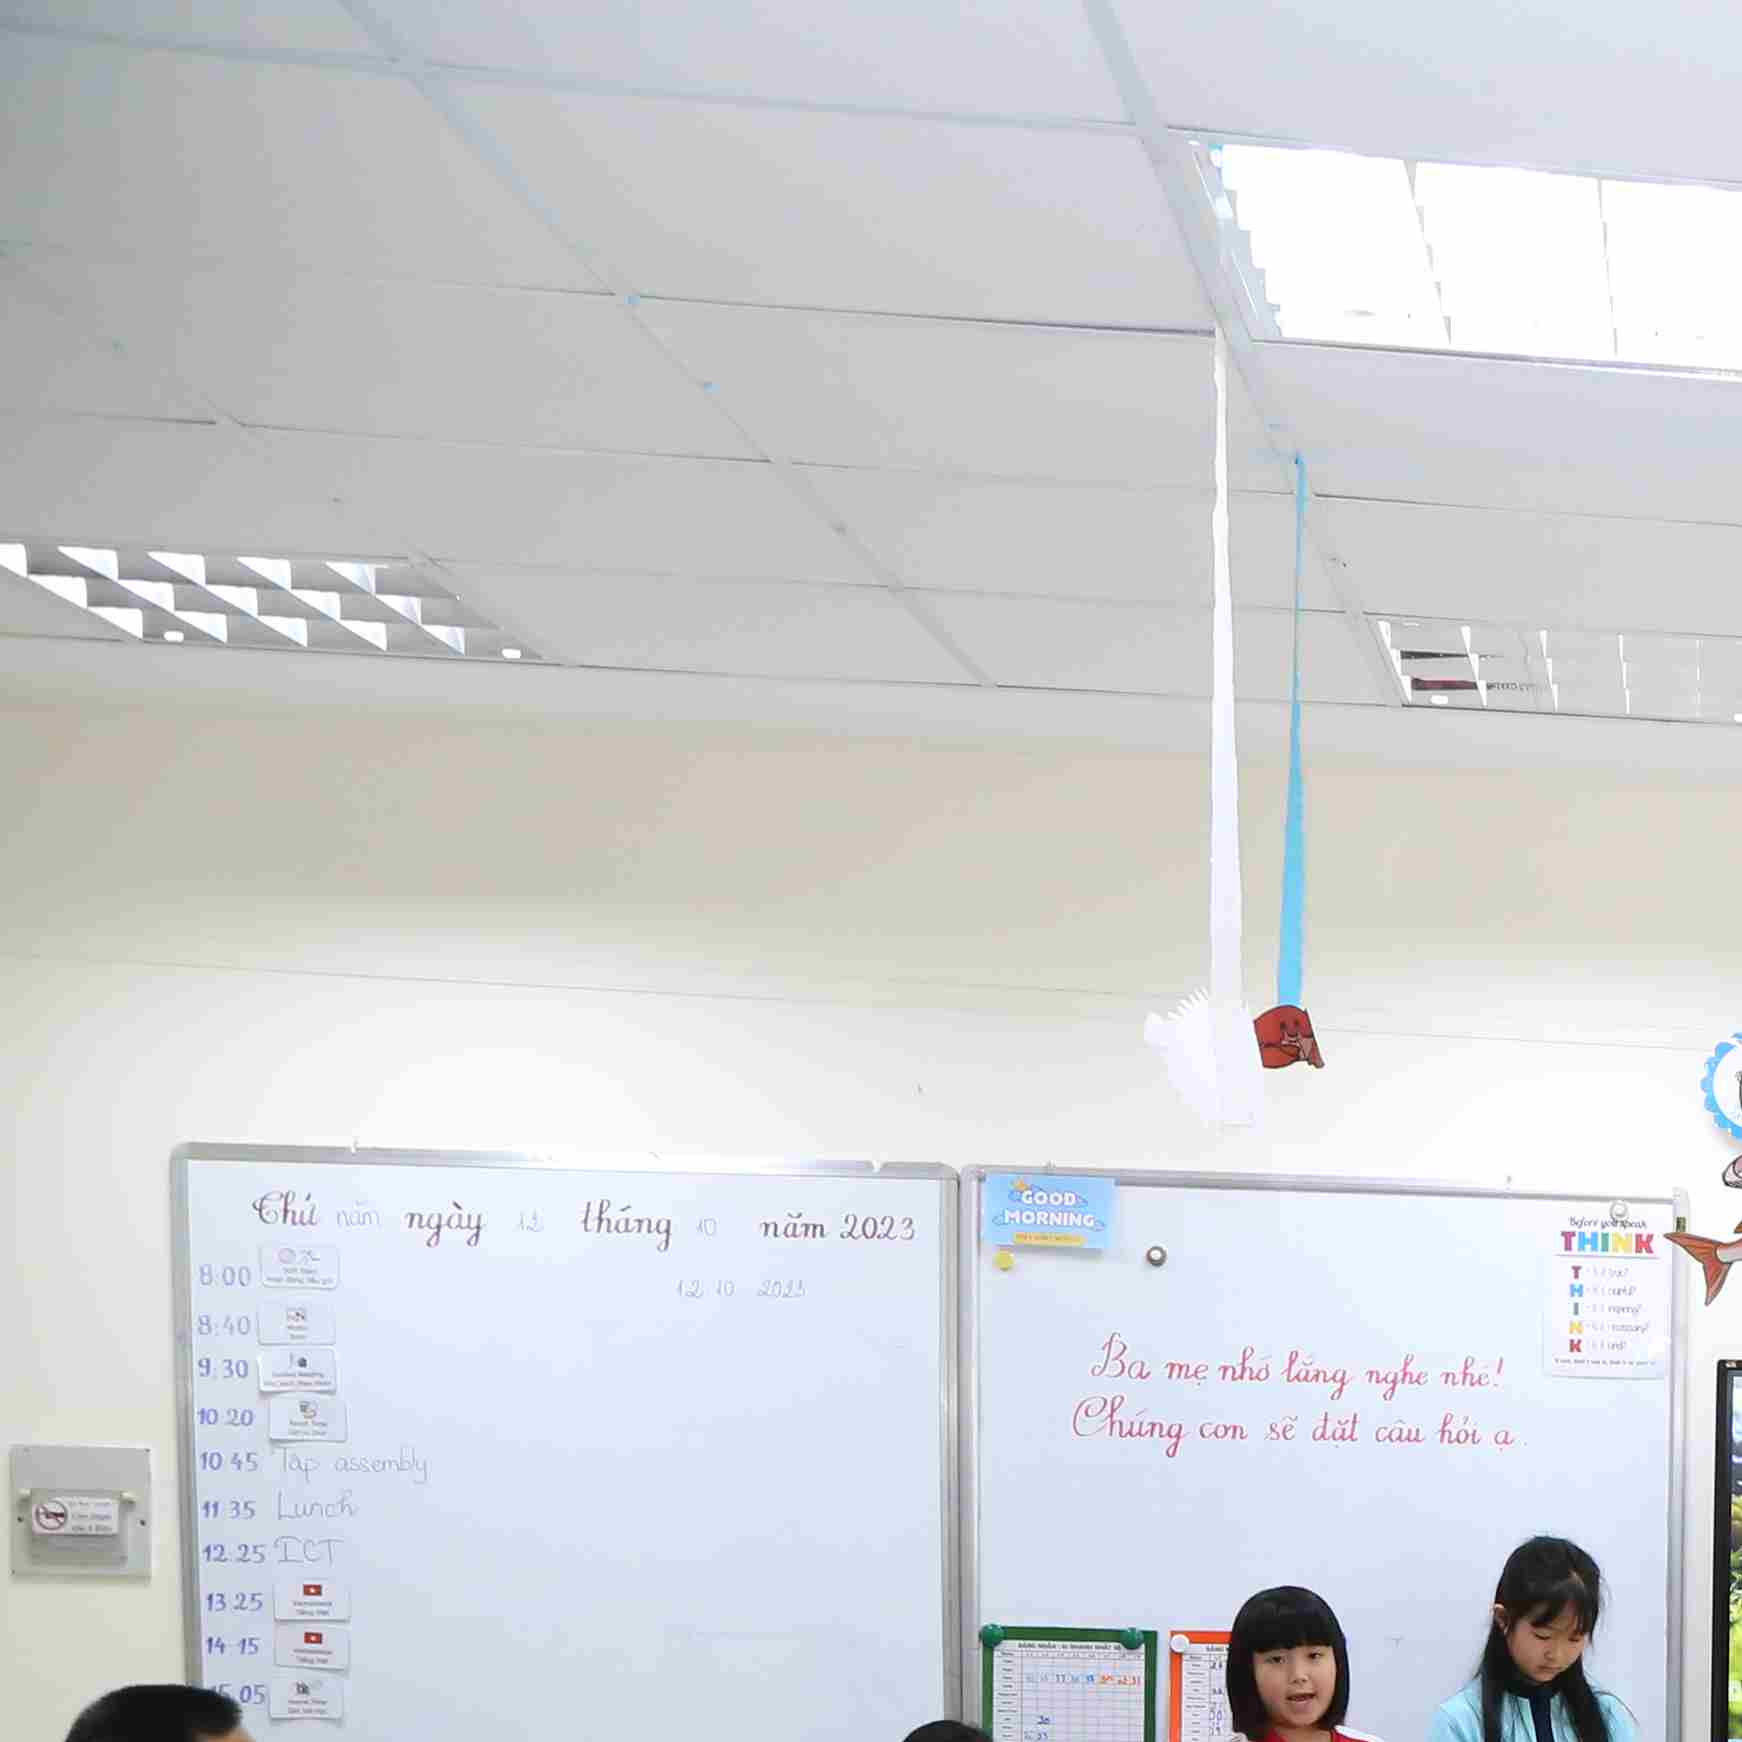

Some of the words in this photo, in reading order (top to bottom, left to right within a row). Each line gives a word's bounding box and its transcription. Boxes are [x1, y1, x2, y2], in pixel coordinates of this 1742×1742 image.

[1022, 1190, 1076, 1205] GOOD
[404, 1200, 484, 1248] ngày
[581, 1199, 672, 1252] tháng
[761, 1212, 827, 1238] năm
[840, 1214, 915, 1241] 2023
[1004, 1209, 1095, 1227] MORNING
[1561, 1231, 1654, 1254] THINK
[1572, 1265, 1582, 1279] T
[1568, 1338, 1583, 1353] K
[1090, 1331, 1151, 1381] Ba
[1365, 1353, 1428, 1400] nghe
[1072, 1395, 1190, 1458] Chúng
[1199, 1420, 1248, 1441] con
[1268, 1415, 1298, 1441] sẽ
[1375, 1420, 1425, 1444] câu
[277, 1490, 358, 1521] Lunch
[273, 1535, 345, 1566] ICT
